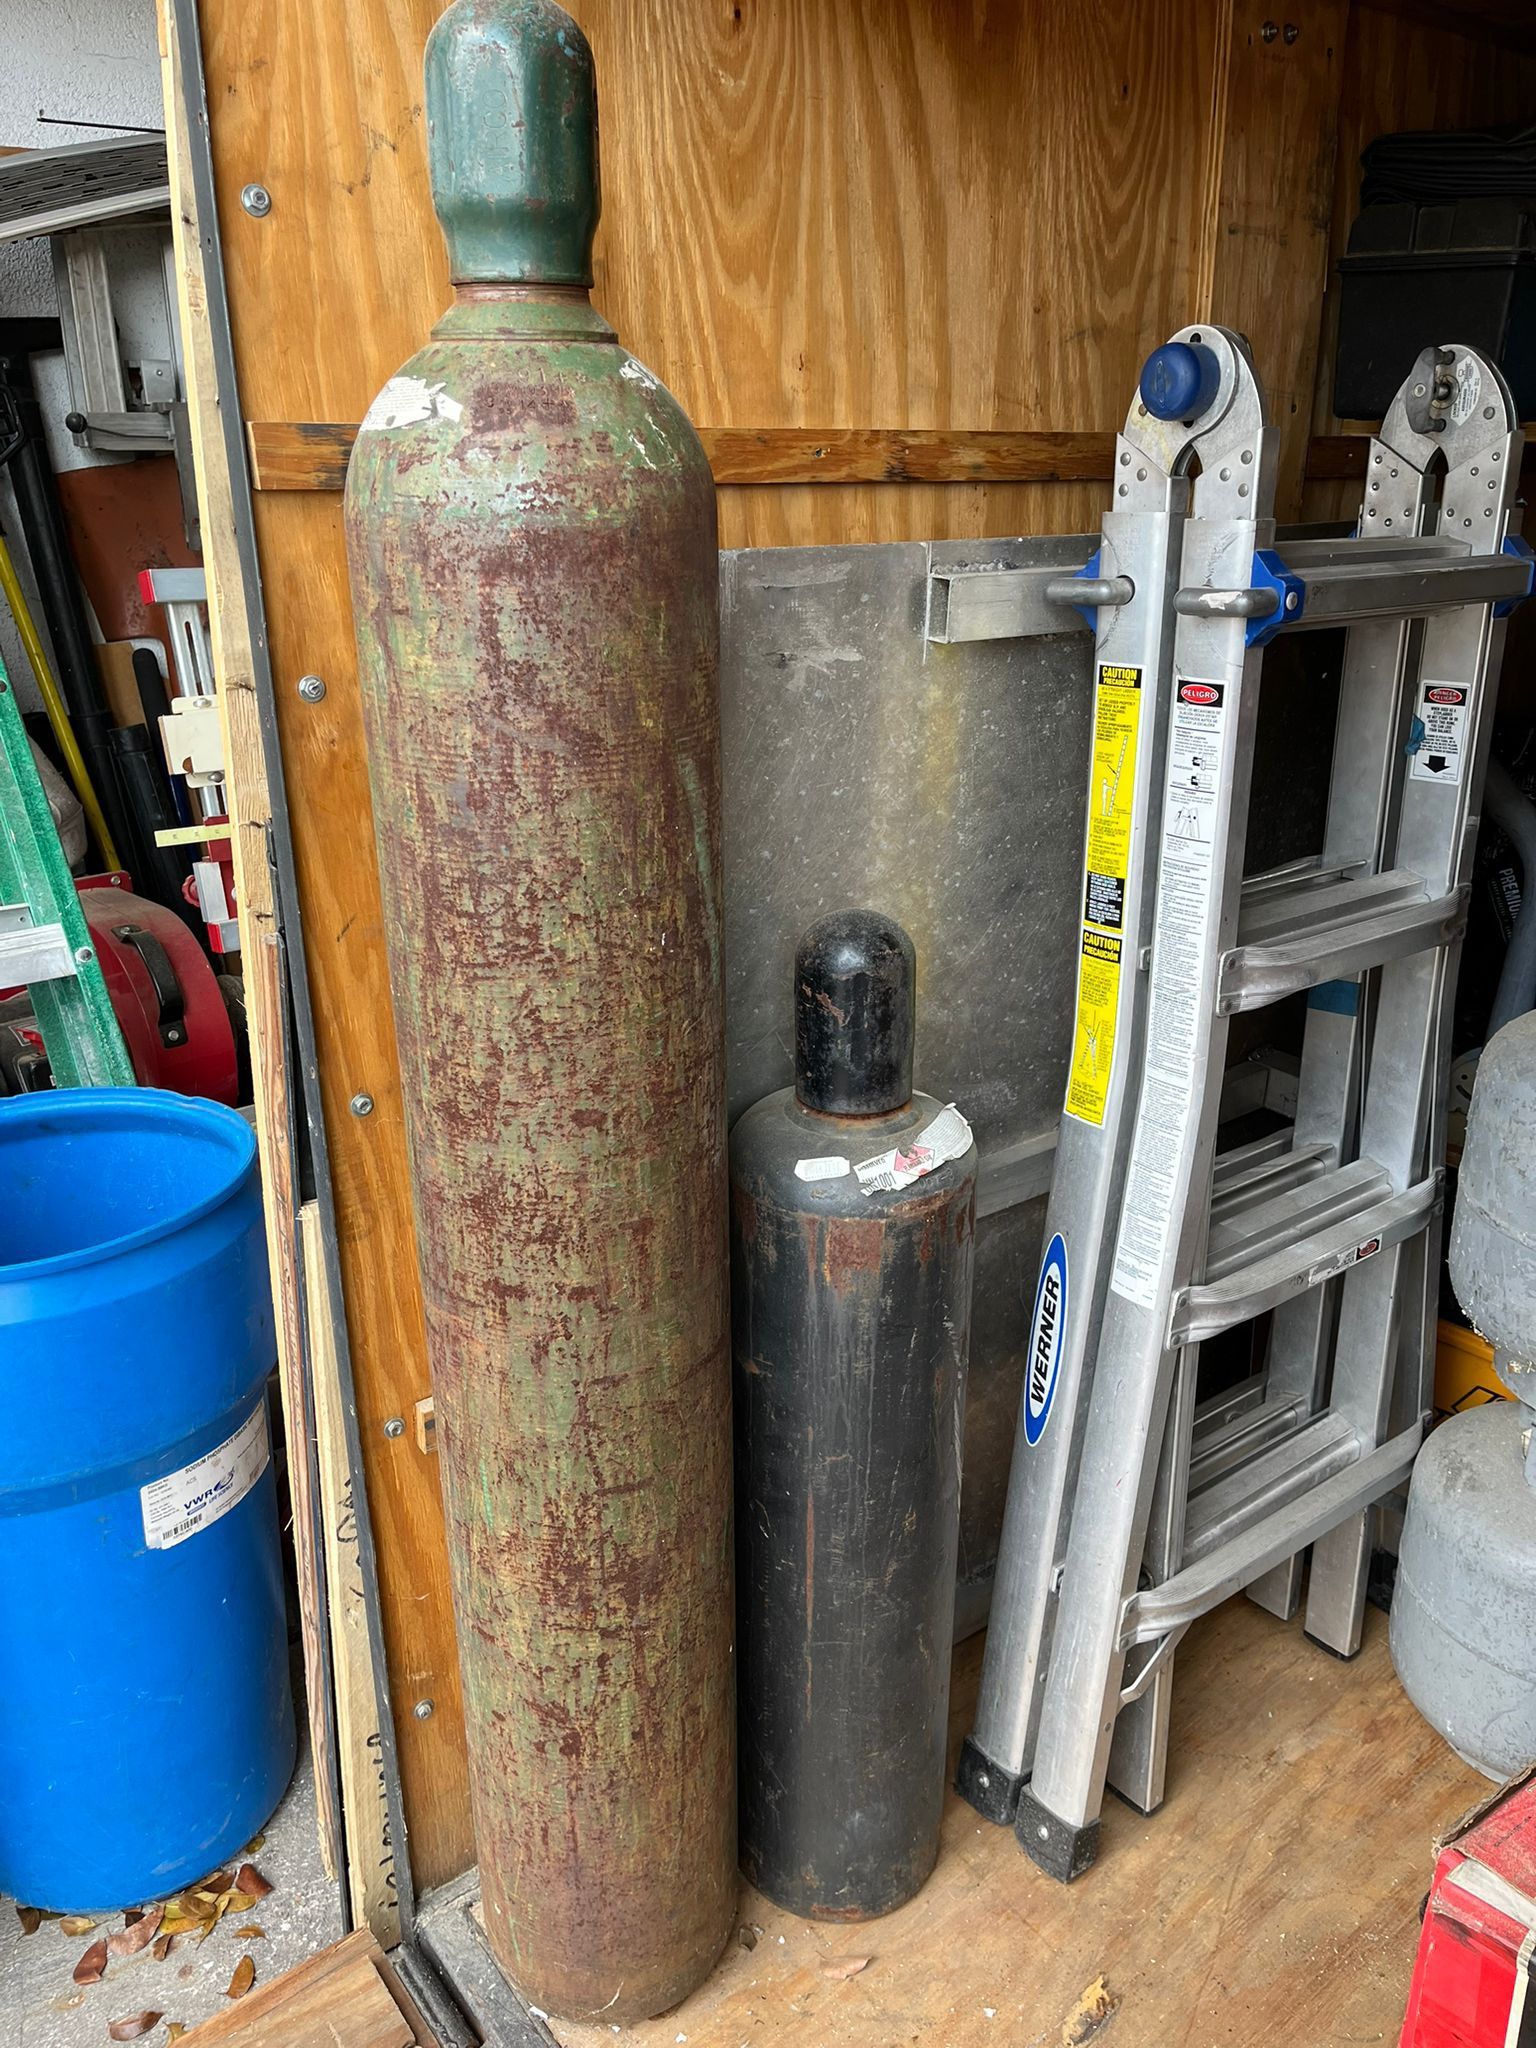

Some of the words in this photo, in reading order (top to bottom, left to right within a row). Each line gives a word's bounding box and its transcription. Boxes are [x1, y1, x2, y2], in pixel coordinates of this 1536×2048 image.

[1102, 666, 1137, 680] CAUTION
[1182, 689, 1217, 700] PELIGRO
[1083, 931, 1121, 951] CAUTION
[1030, 1273, 1060, 1406] WERNER
[184, 1488, 214, 1510] VWR
